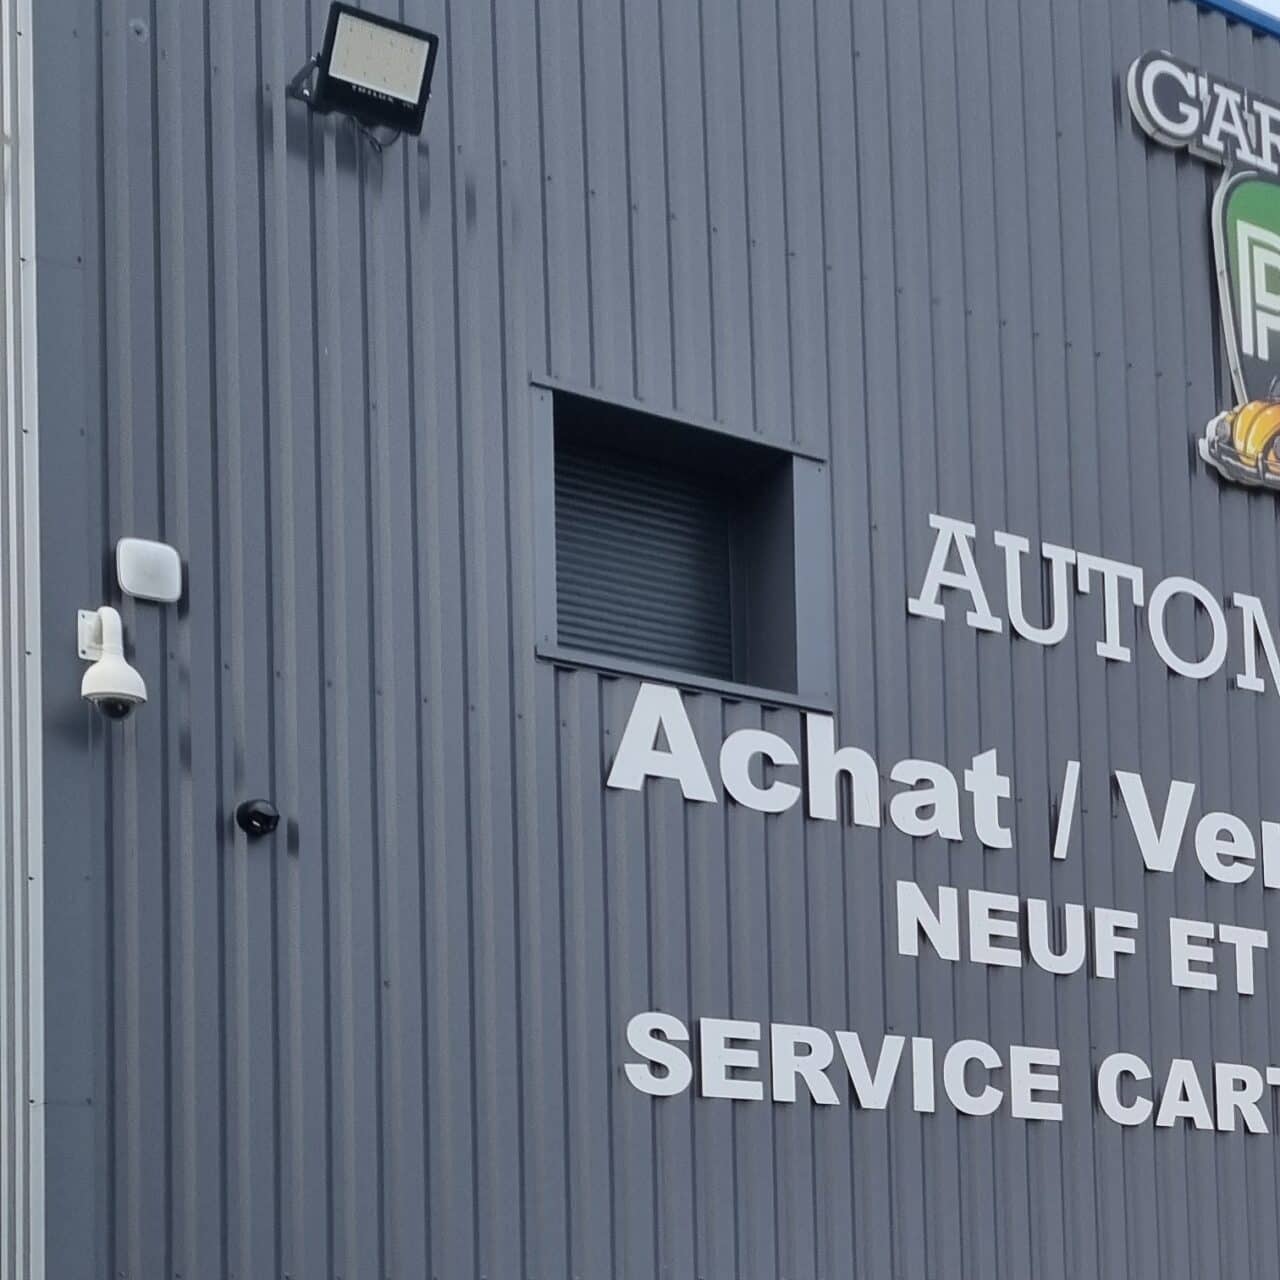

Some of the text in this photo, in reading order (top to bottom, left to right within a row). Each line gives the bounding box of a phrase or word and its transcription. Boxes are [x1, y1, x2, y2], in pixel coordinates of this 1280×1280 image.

[606, 682, 1013, 850] Achat
[896, 880, 1139, 980] NEUF
[1169, 917, 1269, 996] ET
[624, 1012, 1063, 1122] SERVICE
